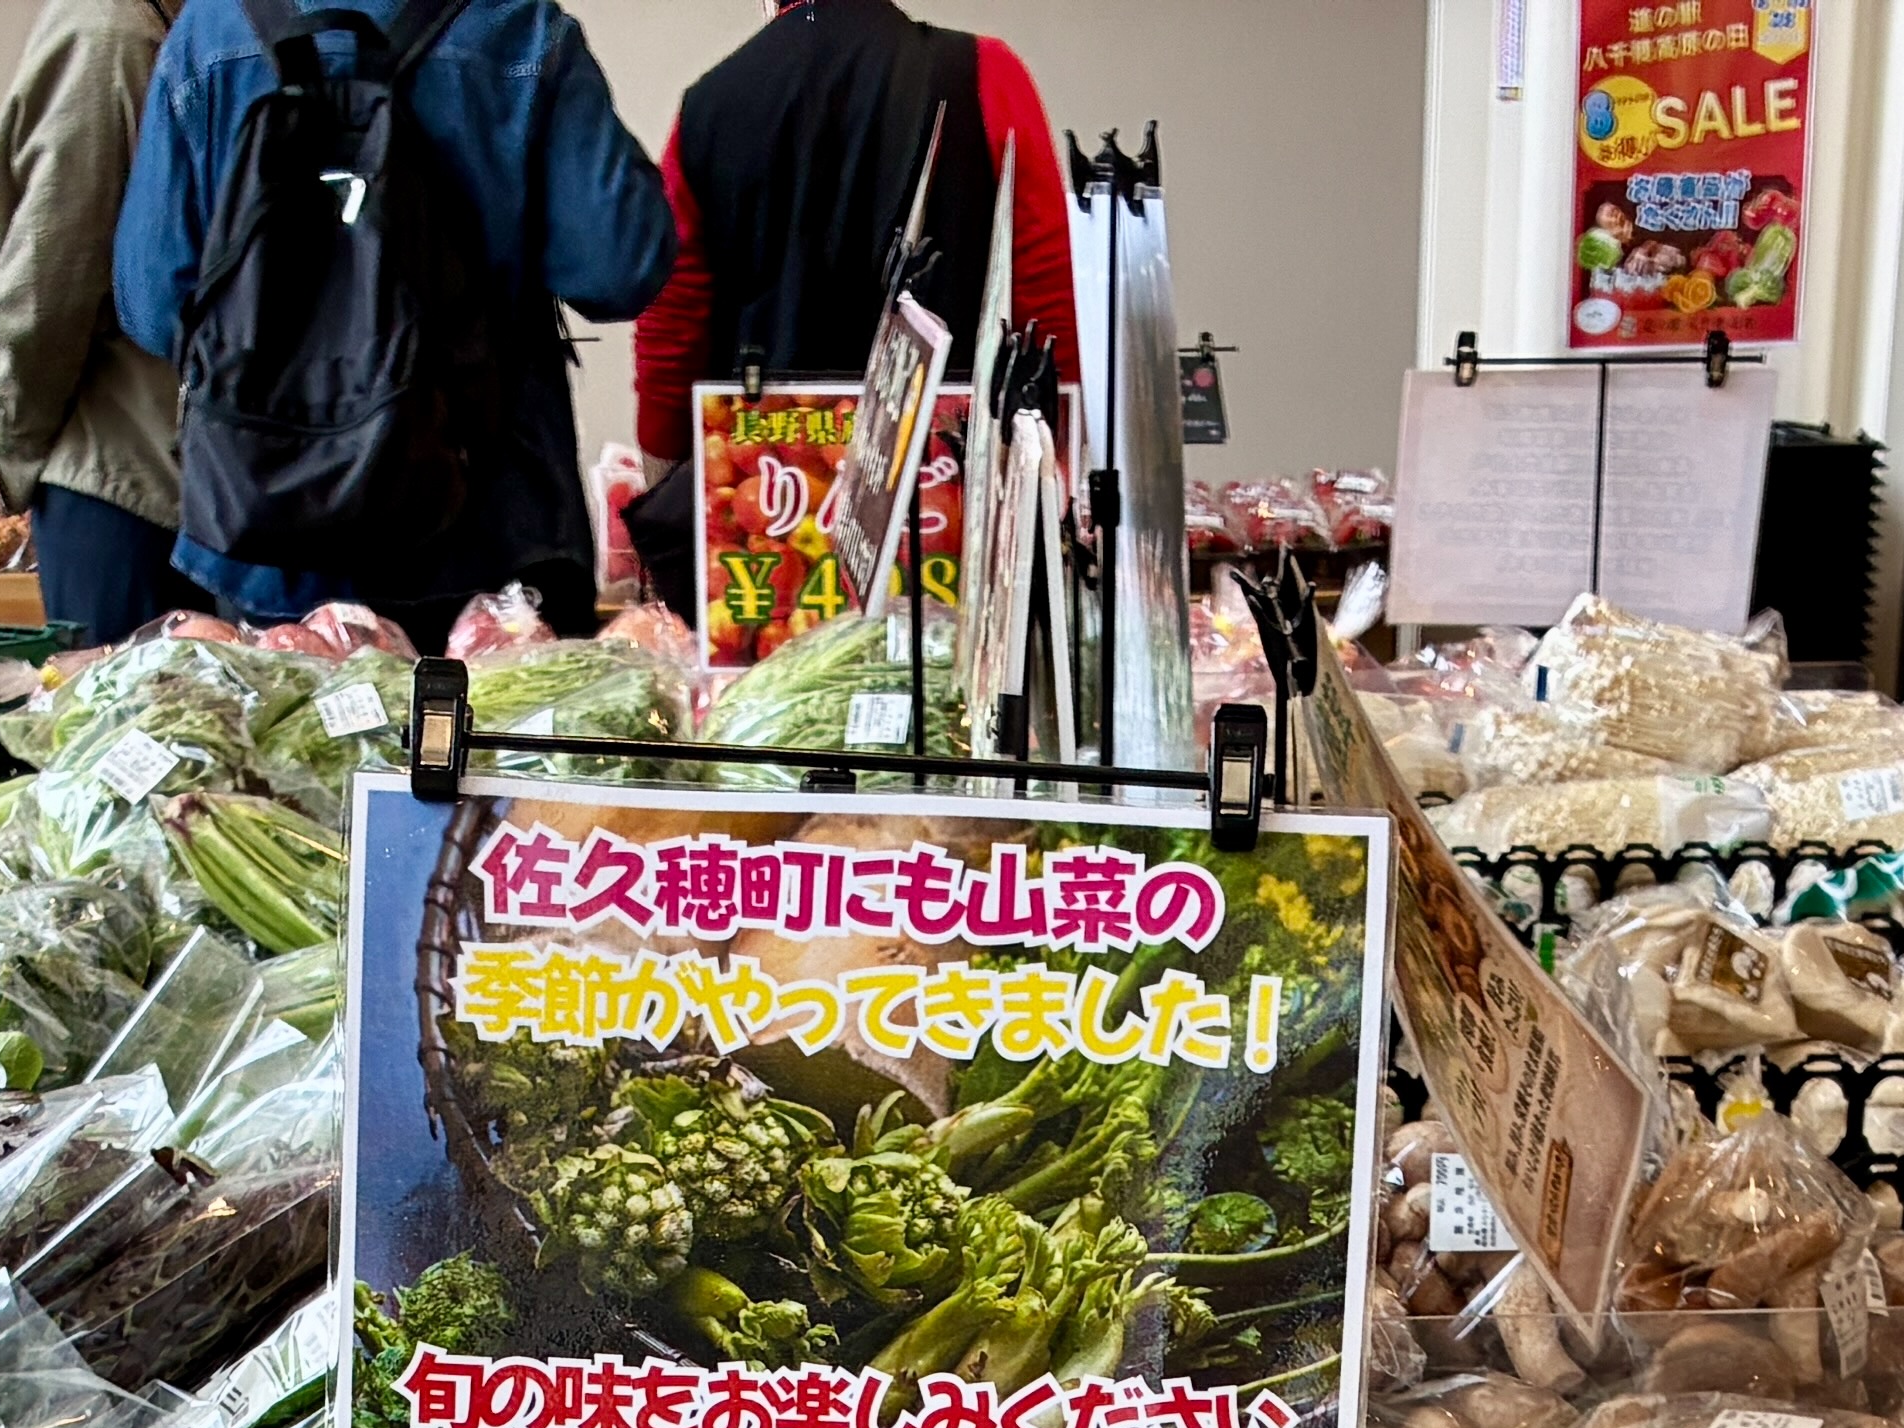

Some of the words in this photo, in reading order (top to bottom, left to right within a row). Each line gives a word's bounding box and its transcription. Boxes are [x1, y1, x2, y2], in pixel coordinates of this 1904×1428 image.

[1655, 78, 1801, 149] SALE
[481, 828, 1218, 946] 佐久穂町にも山菜の
[459, 950, 1280, 1070] 季節がやってきました!
